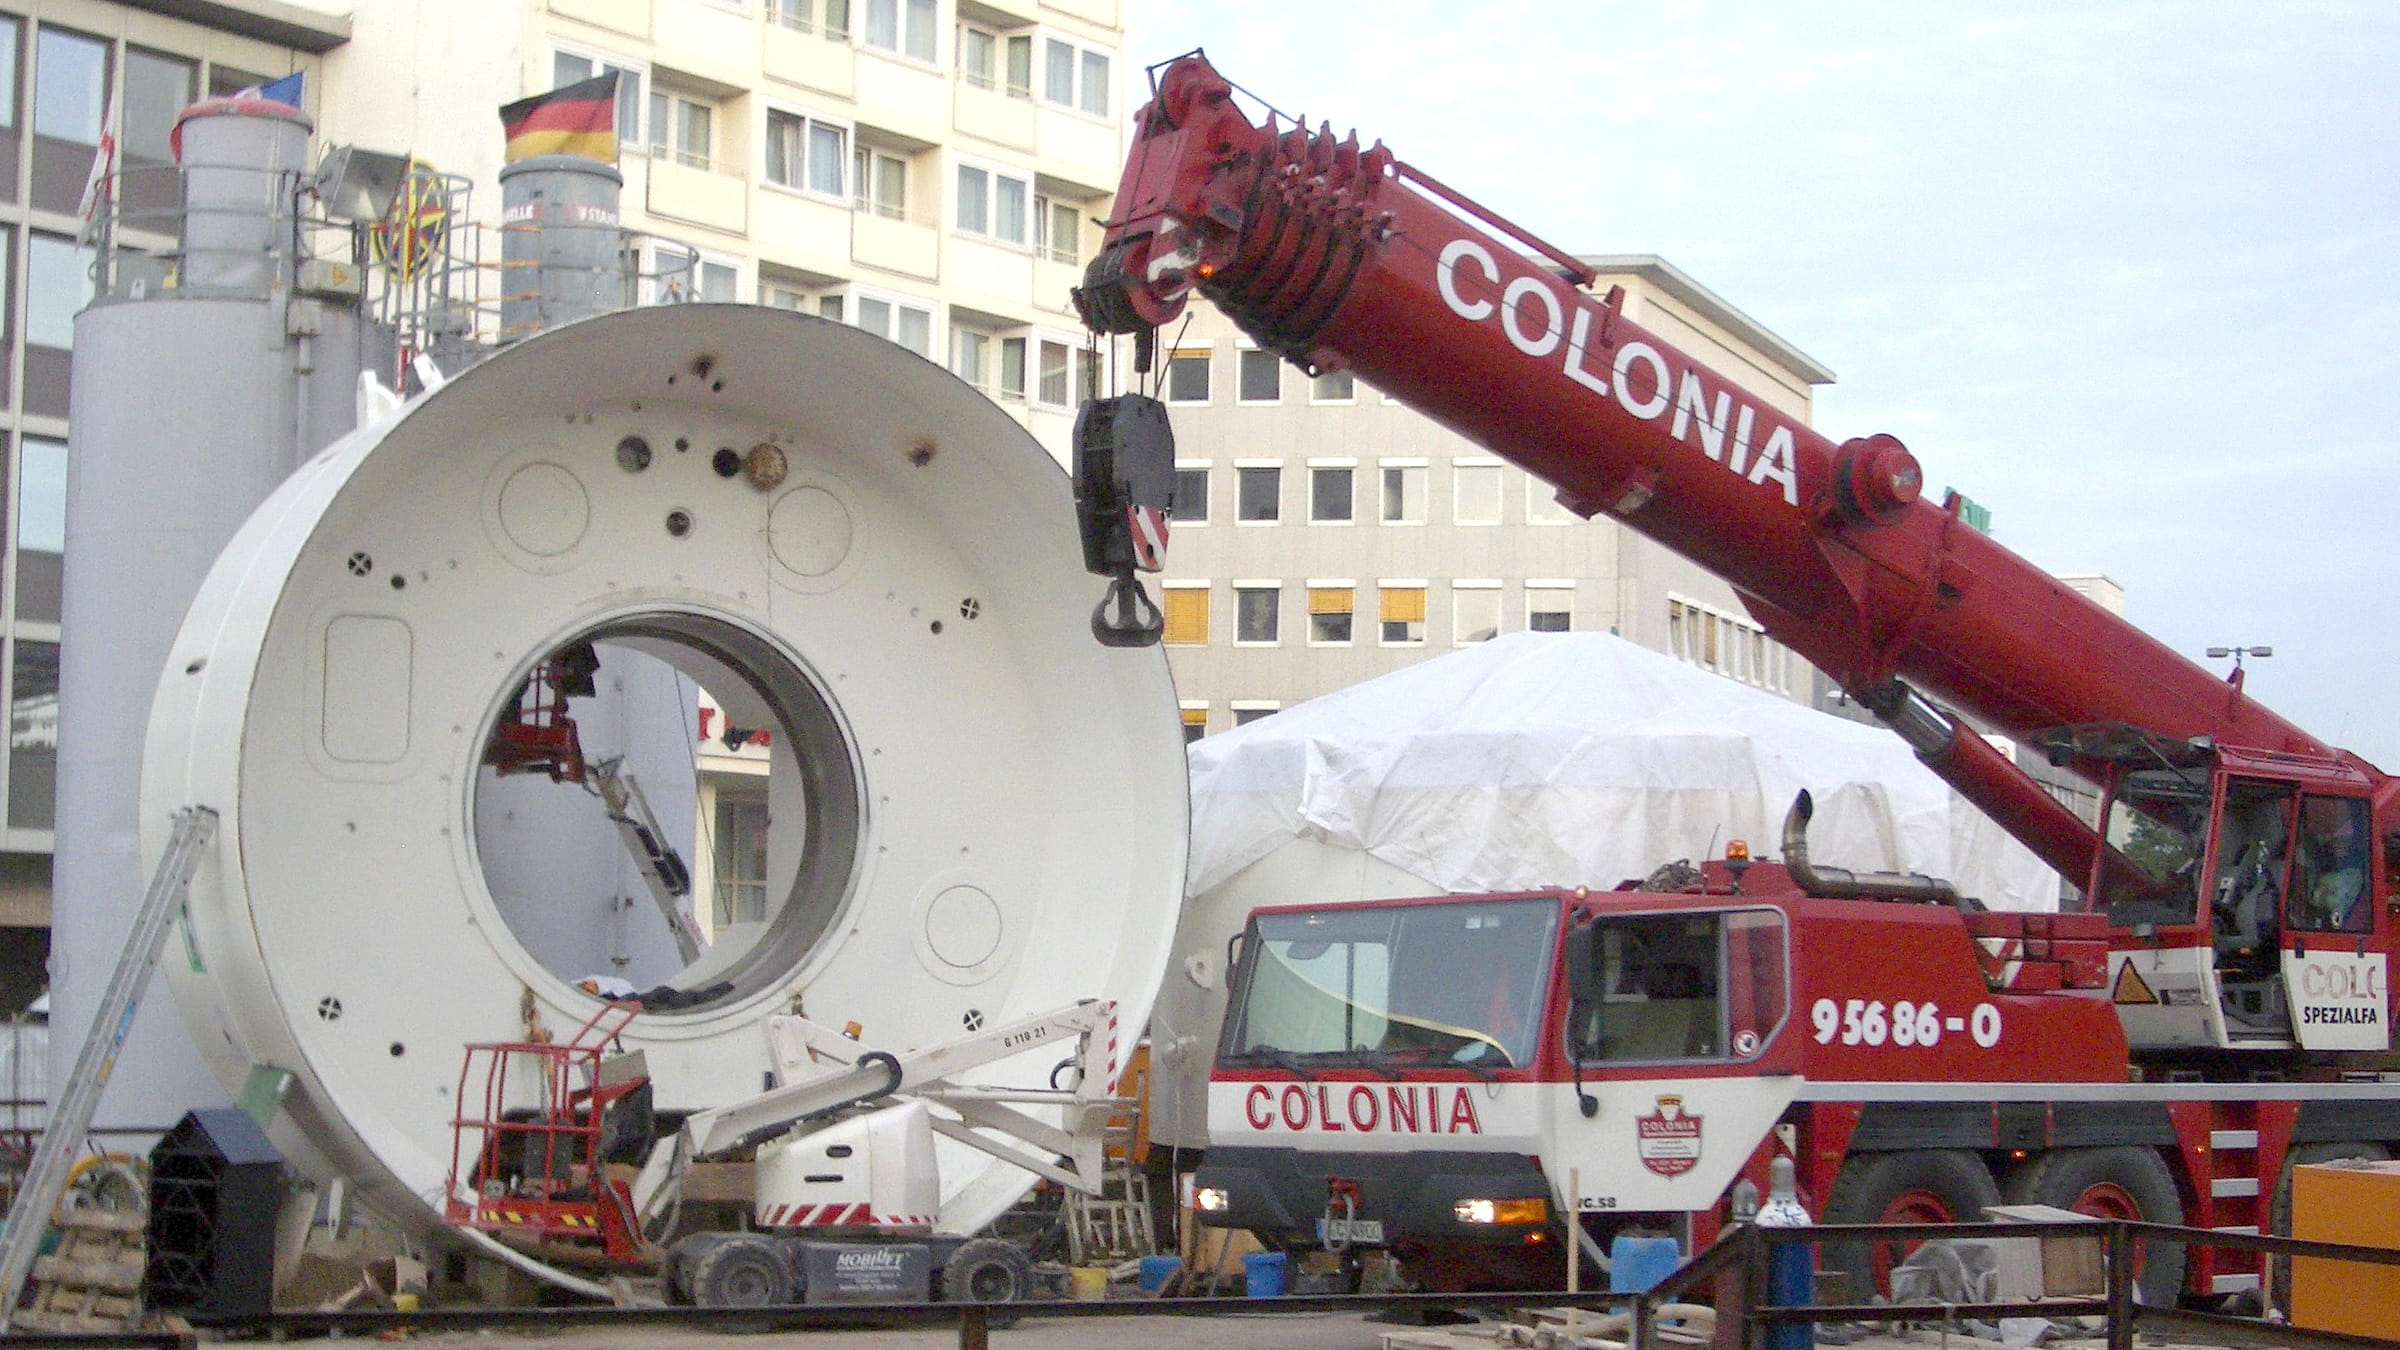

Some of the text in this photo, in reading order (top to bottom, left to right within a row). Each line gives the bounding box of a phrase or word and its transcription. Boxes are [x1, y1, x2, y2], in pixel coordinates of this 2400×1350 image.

[1436, 239, 1799, 507] COLONIA
[2303, 1005, 2378, 1025] SPEZIALFA
[1014, 1031, 1031, 1044] 110
[1033, 1026, 1046, 1038] 21
[1245, 1084, 1482, 1135] COLONIA
[1641, 1120, 1696, 1132] COLONIA
